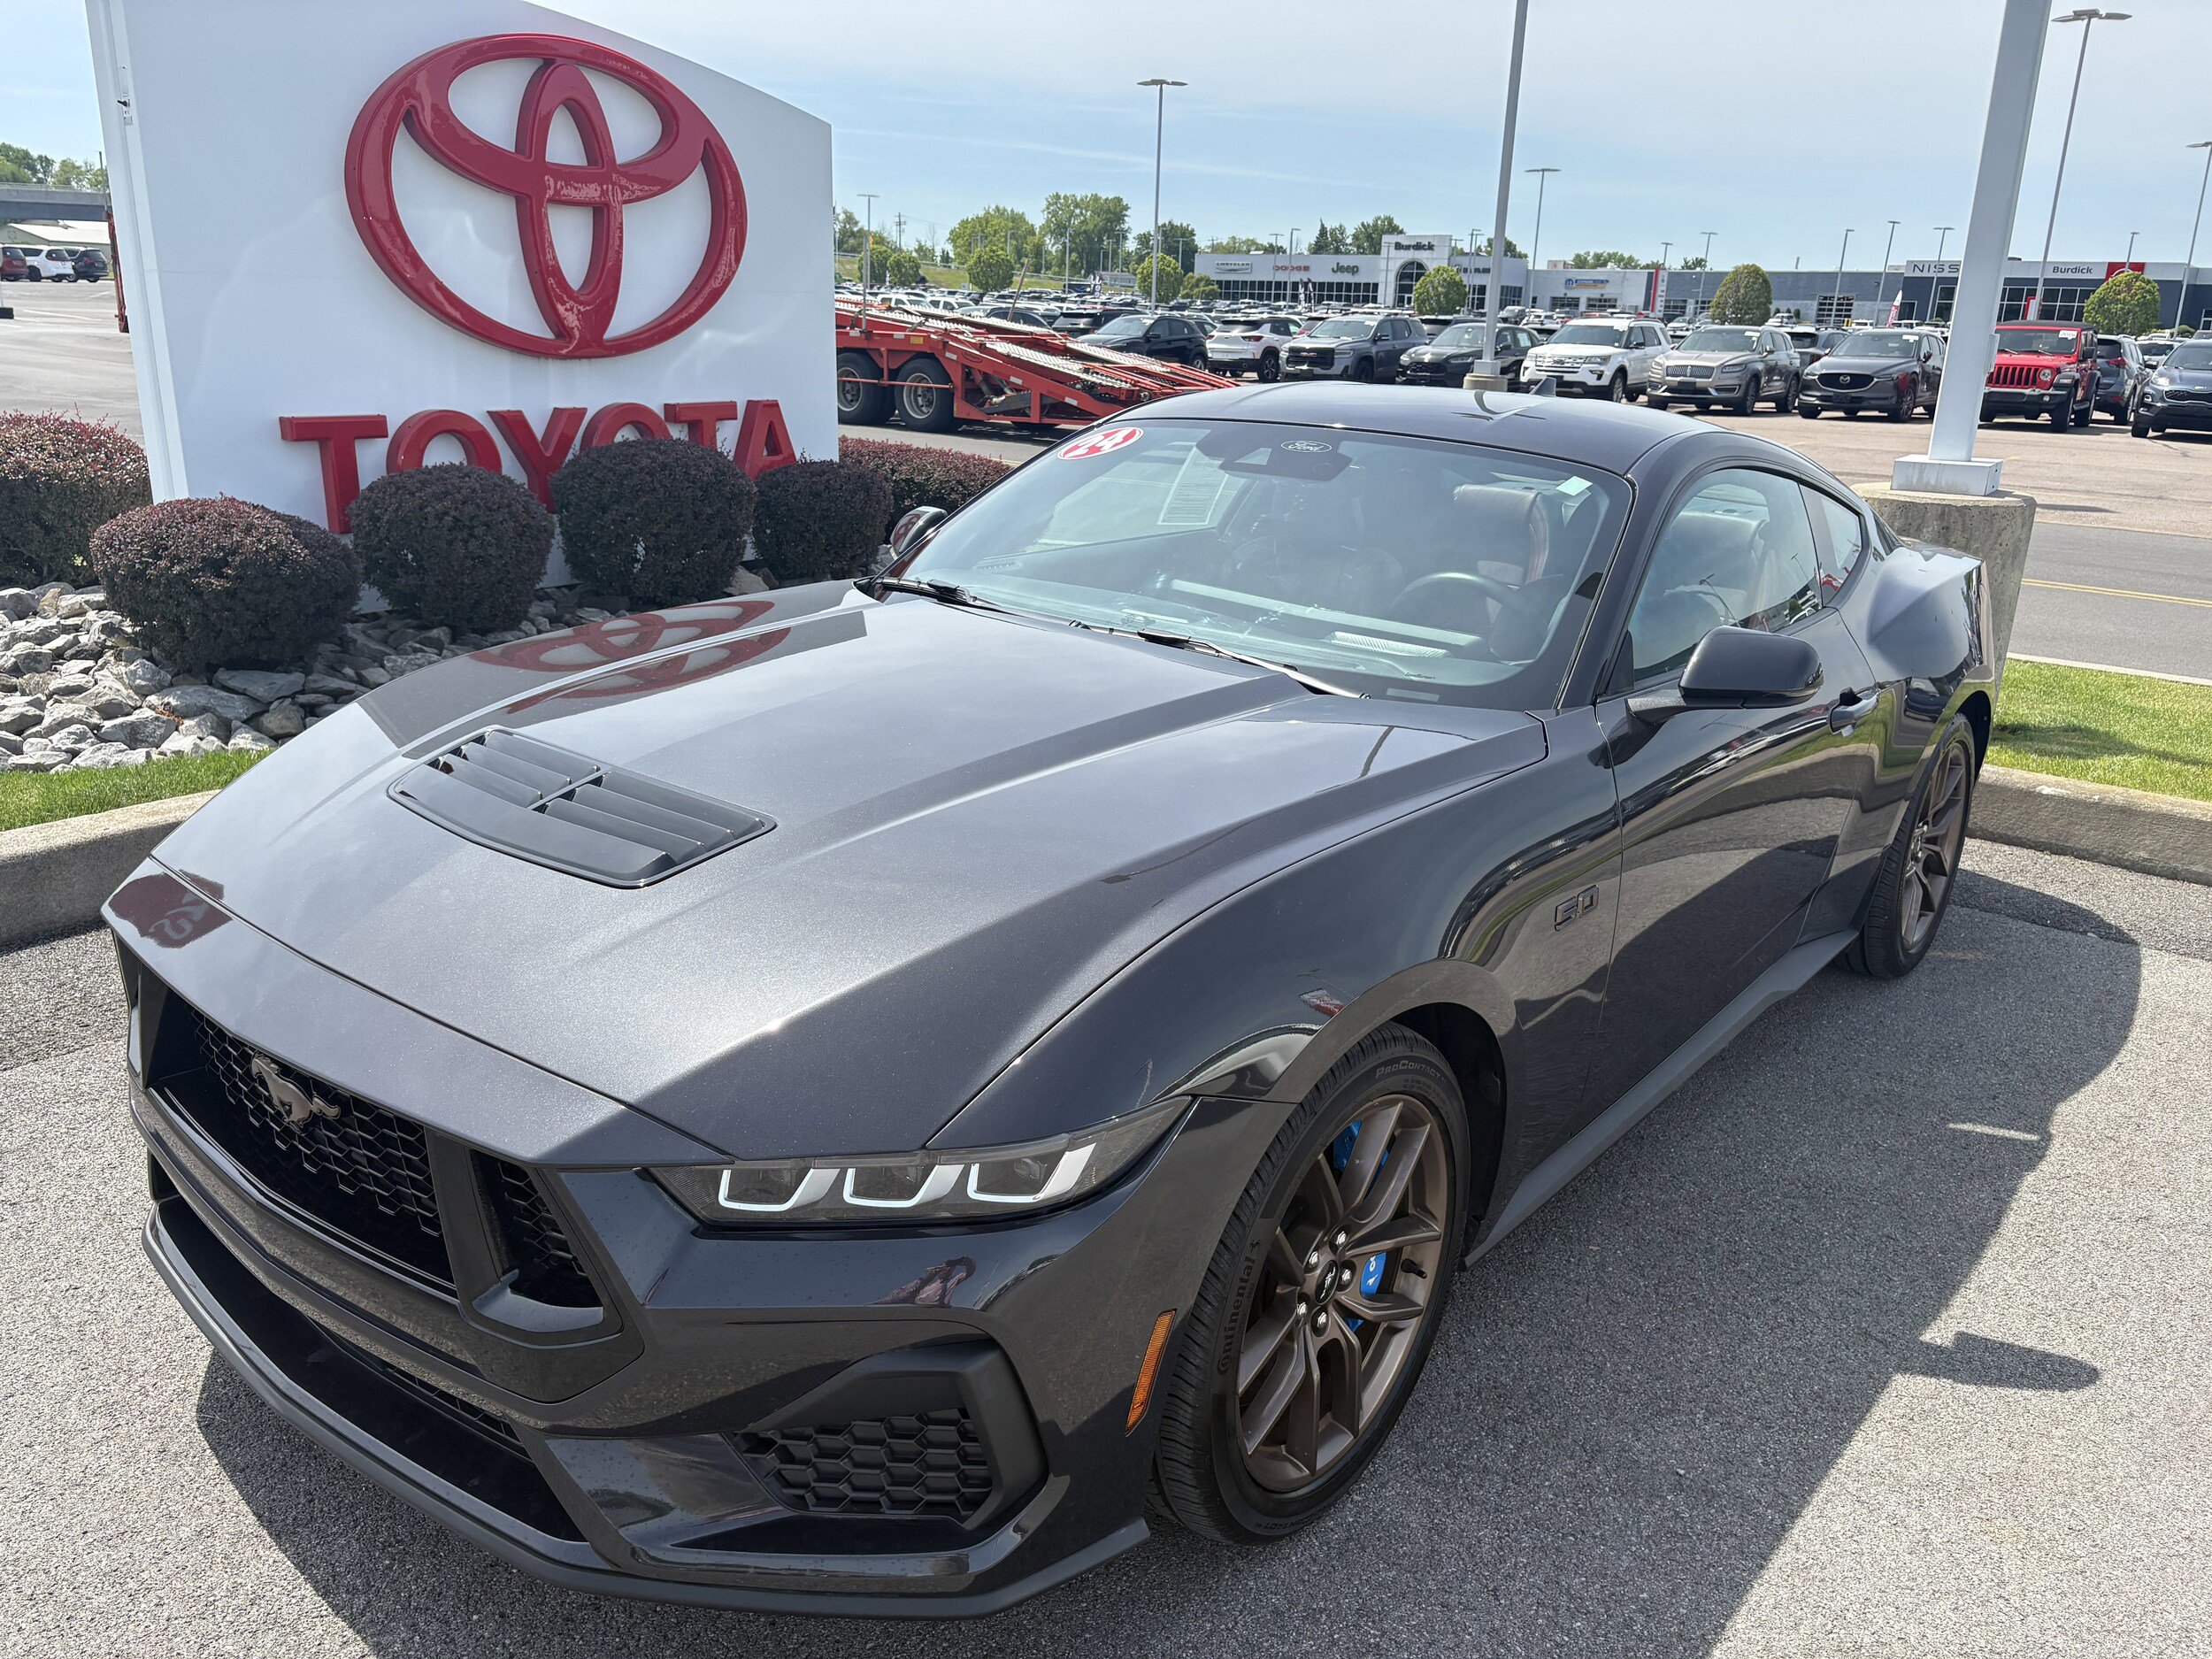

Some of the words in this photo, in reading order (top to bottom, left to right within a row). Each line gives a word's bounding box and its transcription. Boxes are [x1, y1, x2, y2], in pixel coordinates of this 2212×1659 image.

[1394, 242, 1435, 251] Burdick
[1332, 262, 1360, 276] Jeep
[1912, 264, 1959, 273] NISS
[2052, 265, 2093, 274] Burdick
[1064, 428, 1136, 457] 24
[1286, 441, 1325, 451] Ford
[1217, 1256, 1256, 1375] Continental
